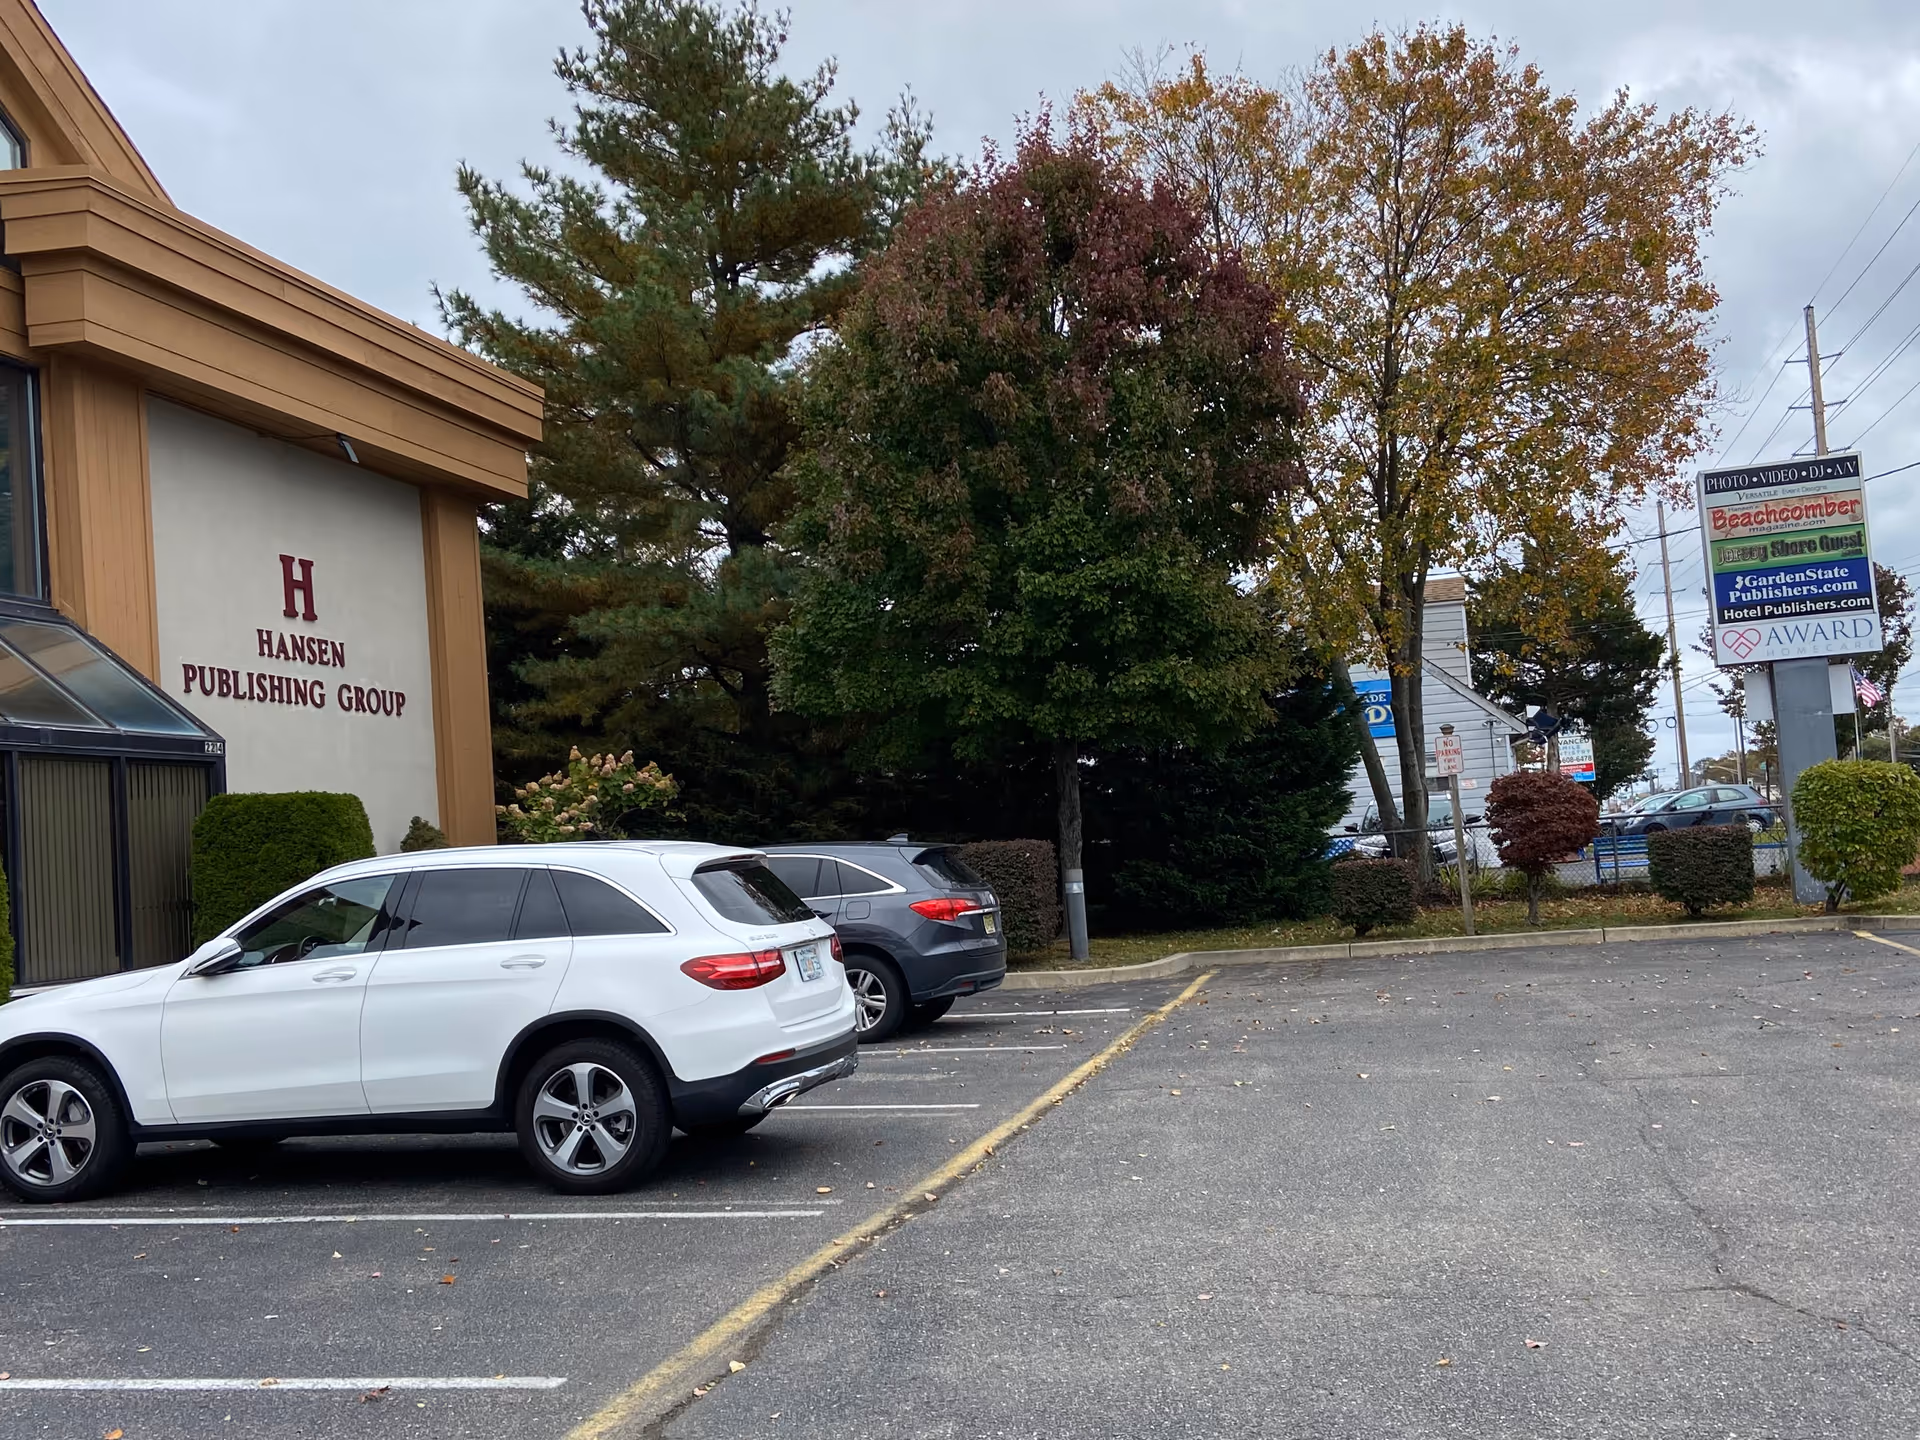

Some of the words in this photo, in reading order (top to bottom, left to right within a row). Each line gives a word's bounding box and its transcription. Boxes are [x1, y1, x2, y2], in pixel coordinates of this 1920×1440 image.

[1706, 474, 1749, 491] PHOTO
[1759, 467, 1798, 484] VIDEO
[1809, 464, 1825, 478] DJ
[1833, 461, 1857, 476] A/V
[1736, 490, 1779, 502] VERSATILE
[1782, 487, 1800, 496] Event
[1711, 496, 1861, 530] Beachcomber
[1748, 518, 1826, 534] magazine.com
[279, 554, 318, 621] H
[1744, 566, 1850, 588] GardenState
[1728, 579, 1858, 603] Publishers.com
[1723, 606, 1762, 620] Hotel
[1764, 597, 1871, 617] Publishers.com
[1765, 618, 1874, 647] AWARD
[256, 628, 346, 668] HANSEN
[182, 663, 326, 709] PUBLISHING
[337, 684, 406, 717] GROUP
[1443, 739, 1454, 747] NO
